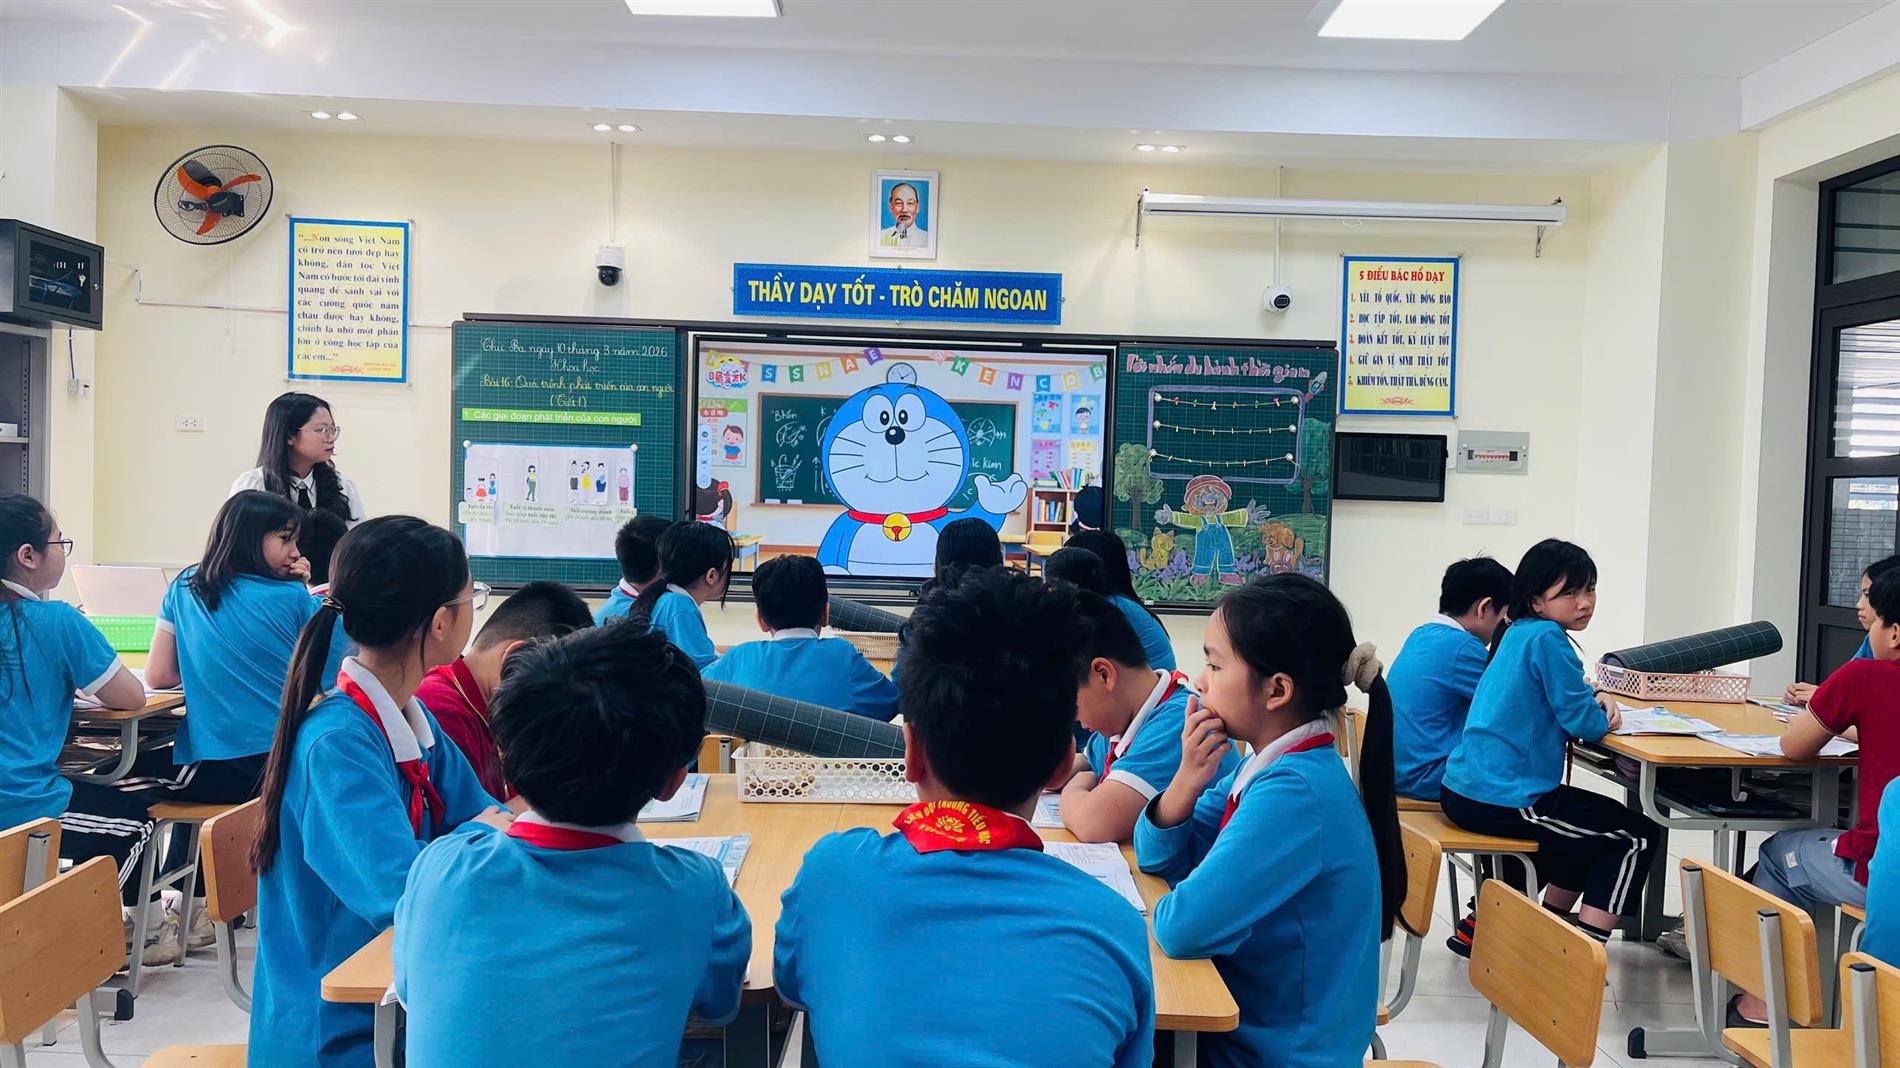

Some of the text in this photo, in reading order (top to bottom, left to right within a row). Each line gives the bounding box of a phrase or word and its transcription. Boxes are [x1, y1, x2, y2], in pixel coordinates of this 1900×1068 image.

[380, 236, 400, 246] Nam
[384, 249, 400, 260] hay
[298, 272, 319, 280] Nam
[1360, 266, 1445, 284] 5 ĐIỀU BÁC HỒ DẠY
[298, 286, 325, 295] quang
[748, 272, 796, 304] THẦY
[800, 283, 838, 310] DẠY
[842, 274, 875, 306] TỐT
[889, 280, 924, 308] TRÒ
[928, 281, 979, 309] CHĂM
[984, 288, 1047, 311] NGOAN
[349, 314, 364, 322] hay
[509, 338, 524, 352] Ba
[529, 344, 554, 360] ngày
[557, 342, 566, 354] 10
[567, 342, 600, 361] tháng
[604, 344, 610, 356] 3
[642, 346, 668, 358] 2026
[1184, 355, 1202, 375] du
[474, 410, 491, 419] Các
[493, 412, 508, 421] giai
[510, 412, 532, 421] đoạn
[534, 412, 553, 422] phát
[555, 412, 574, 422] triển
[576, 413, 592, 422] của
[611, 414, 636, 424] người
